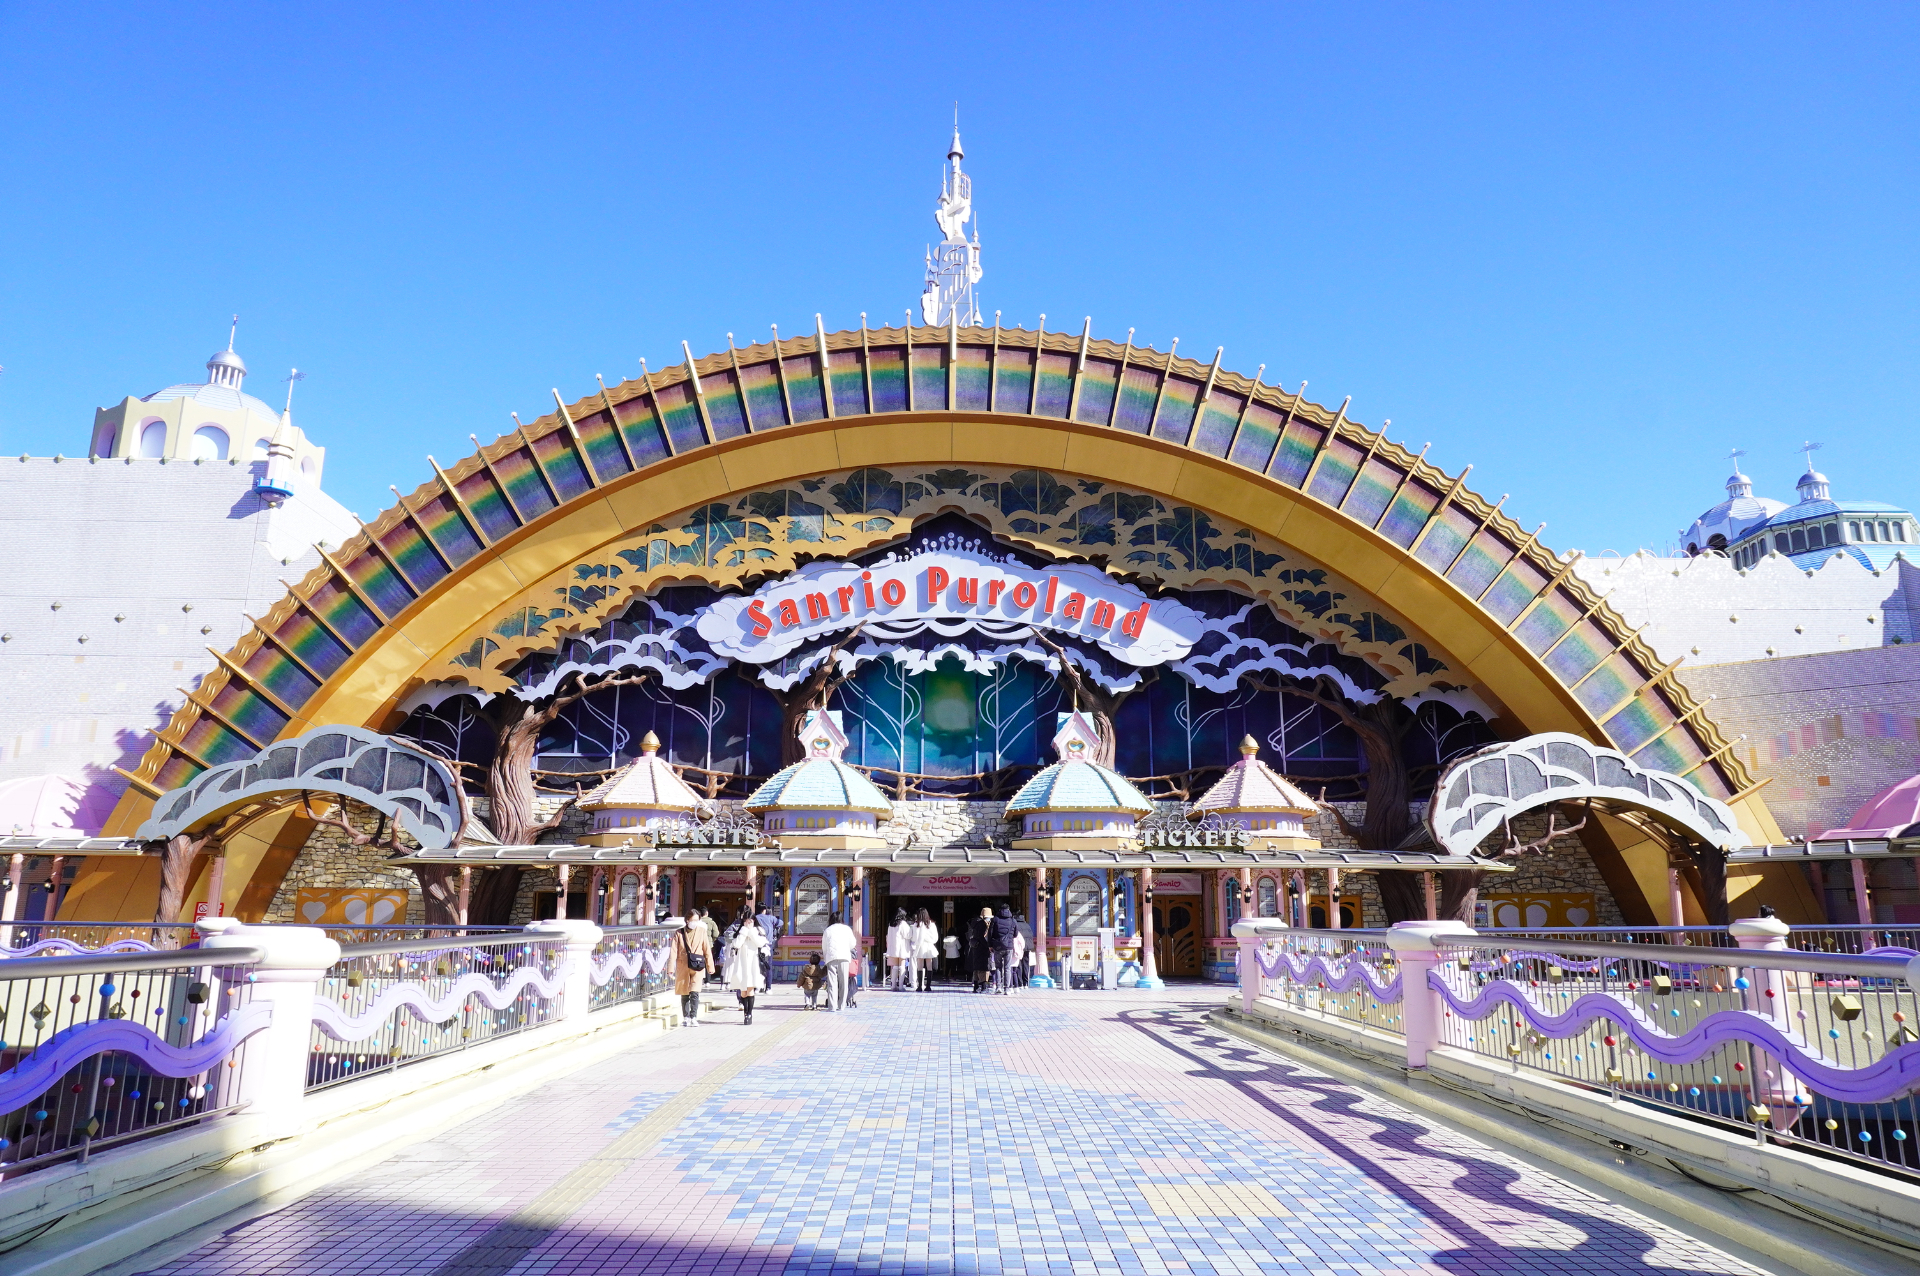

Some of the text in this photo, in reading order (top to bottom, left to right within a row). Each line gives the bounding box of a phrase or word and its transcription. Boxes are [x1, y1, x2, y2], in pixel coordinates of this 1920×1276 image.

[747, 566, 1152, 639] Sanrio Puroland
[651, 827, 760, 846] TICKETS
[1141, 829, 1252, 847] TICKETS
[716, 876, 746, 886] Sanrio
